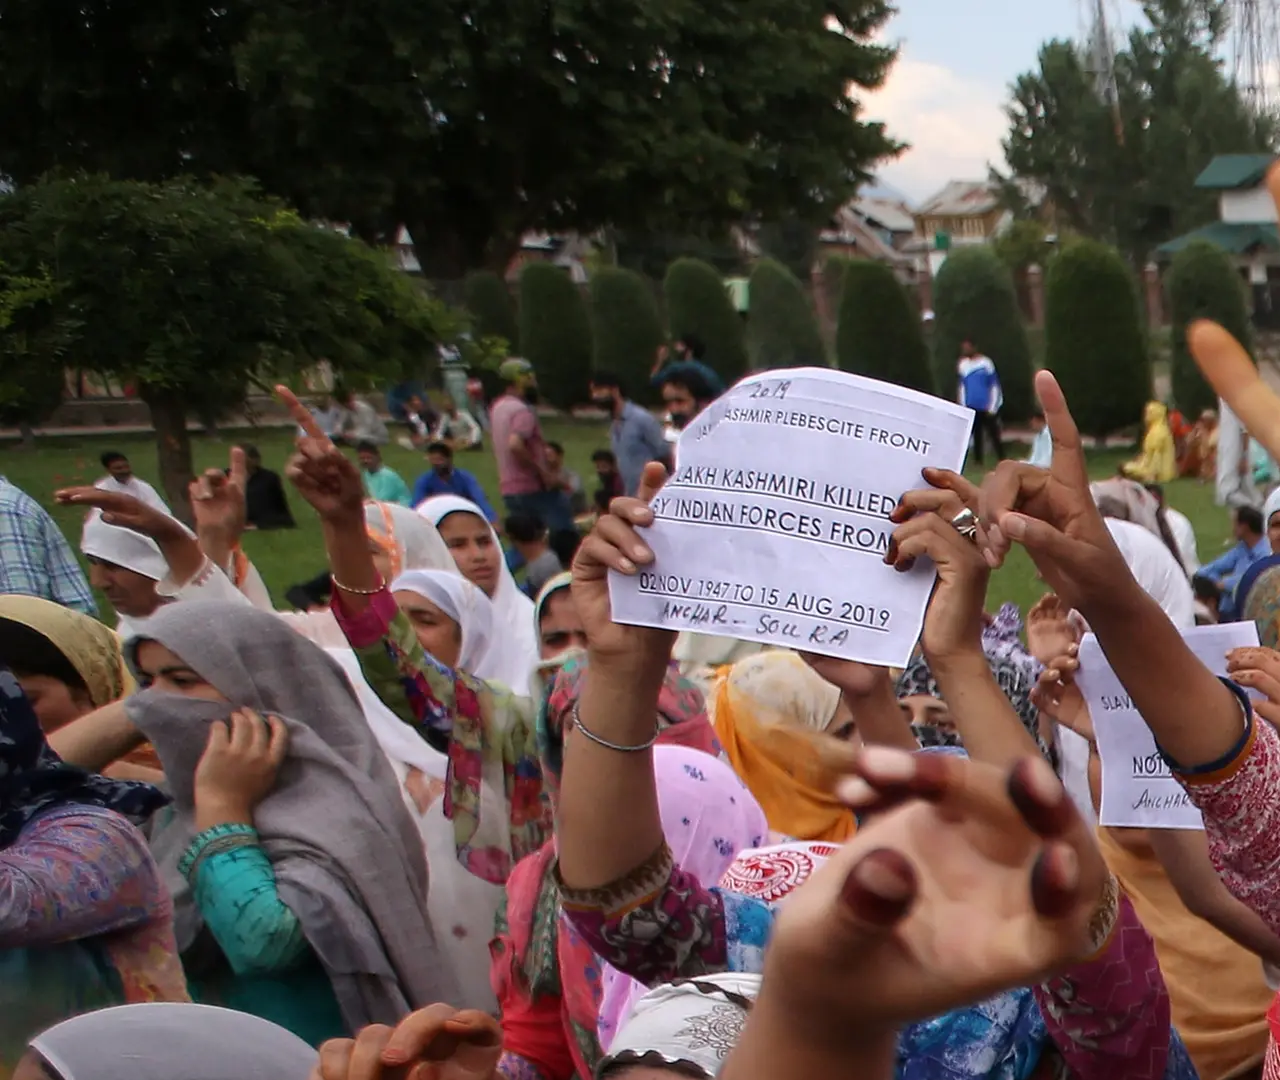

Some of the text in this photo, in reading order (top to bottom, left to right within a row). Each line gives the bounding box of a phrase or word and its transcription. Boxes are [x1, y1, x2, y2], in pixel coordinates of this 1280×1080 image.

[749, 380, 792, 400] 2019
[724, 407, 772, 424] ASHMIR
[775, 410, 865, 439] PLEBESCITE
[869, 427, 931, 455] FRONT
[722, 468, 815, 500] KASHMIRI
[824, 484, 896, 515] KILLED
[675, 499, 735, 523] INDIAN
[740, 505, 822, 537] FORCES
[639, 572, 890, 627] 02 NOV 1947 TO 15 AUG 2019
[1132, 755, 1163, 774] NOT
